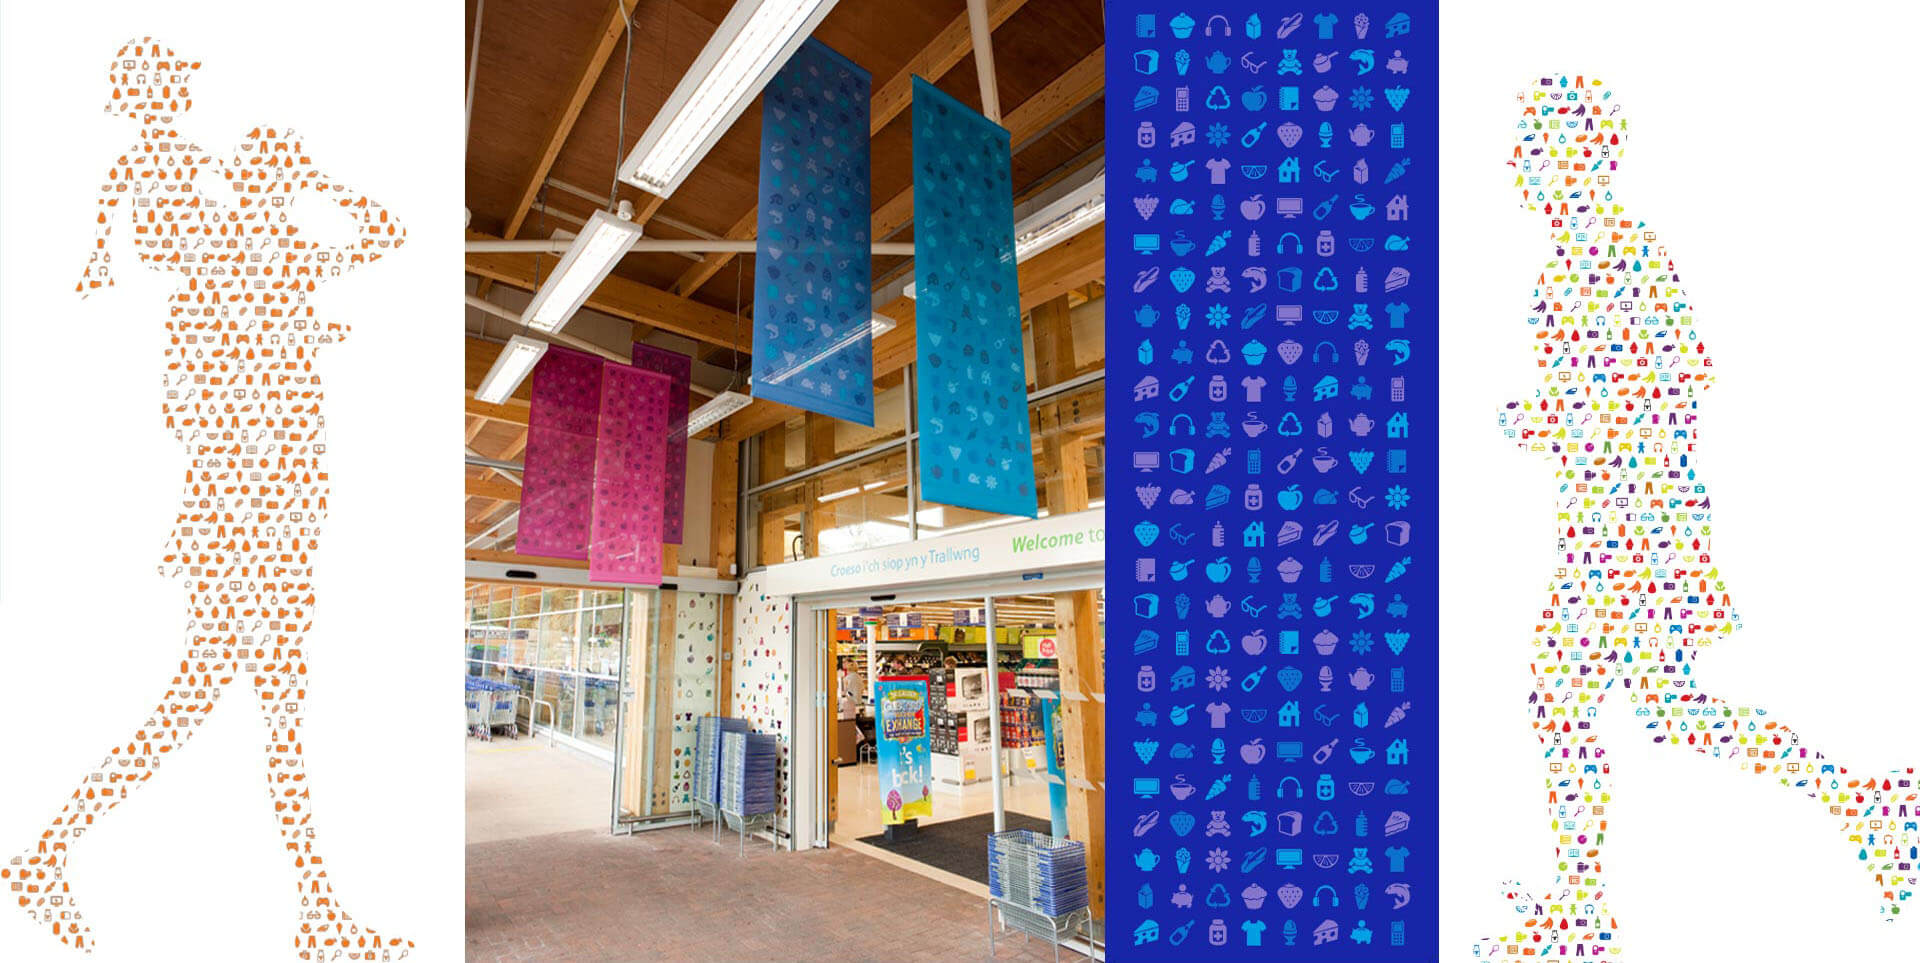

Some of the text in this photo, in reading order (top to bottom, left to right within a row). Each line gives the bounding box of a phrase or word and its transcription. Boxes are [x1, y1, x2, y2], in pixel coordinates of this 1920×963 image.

[1012, 528, 1104, 553] Welcome to
[830, 564, 861, 577] Croeso
[882, 557, 902, 571] siop
[904, 555, 918, 571] yn
[920, 555, 928, 568] y
[929, 546, 980, 563] Trallwng
